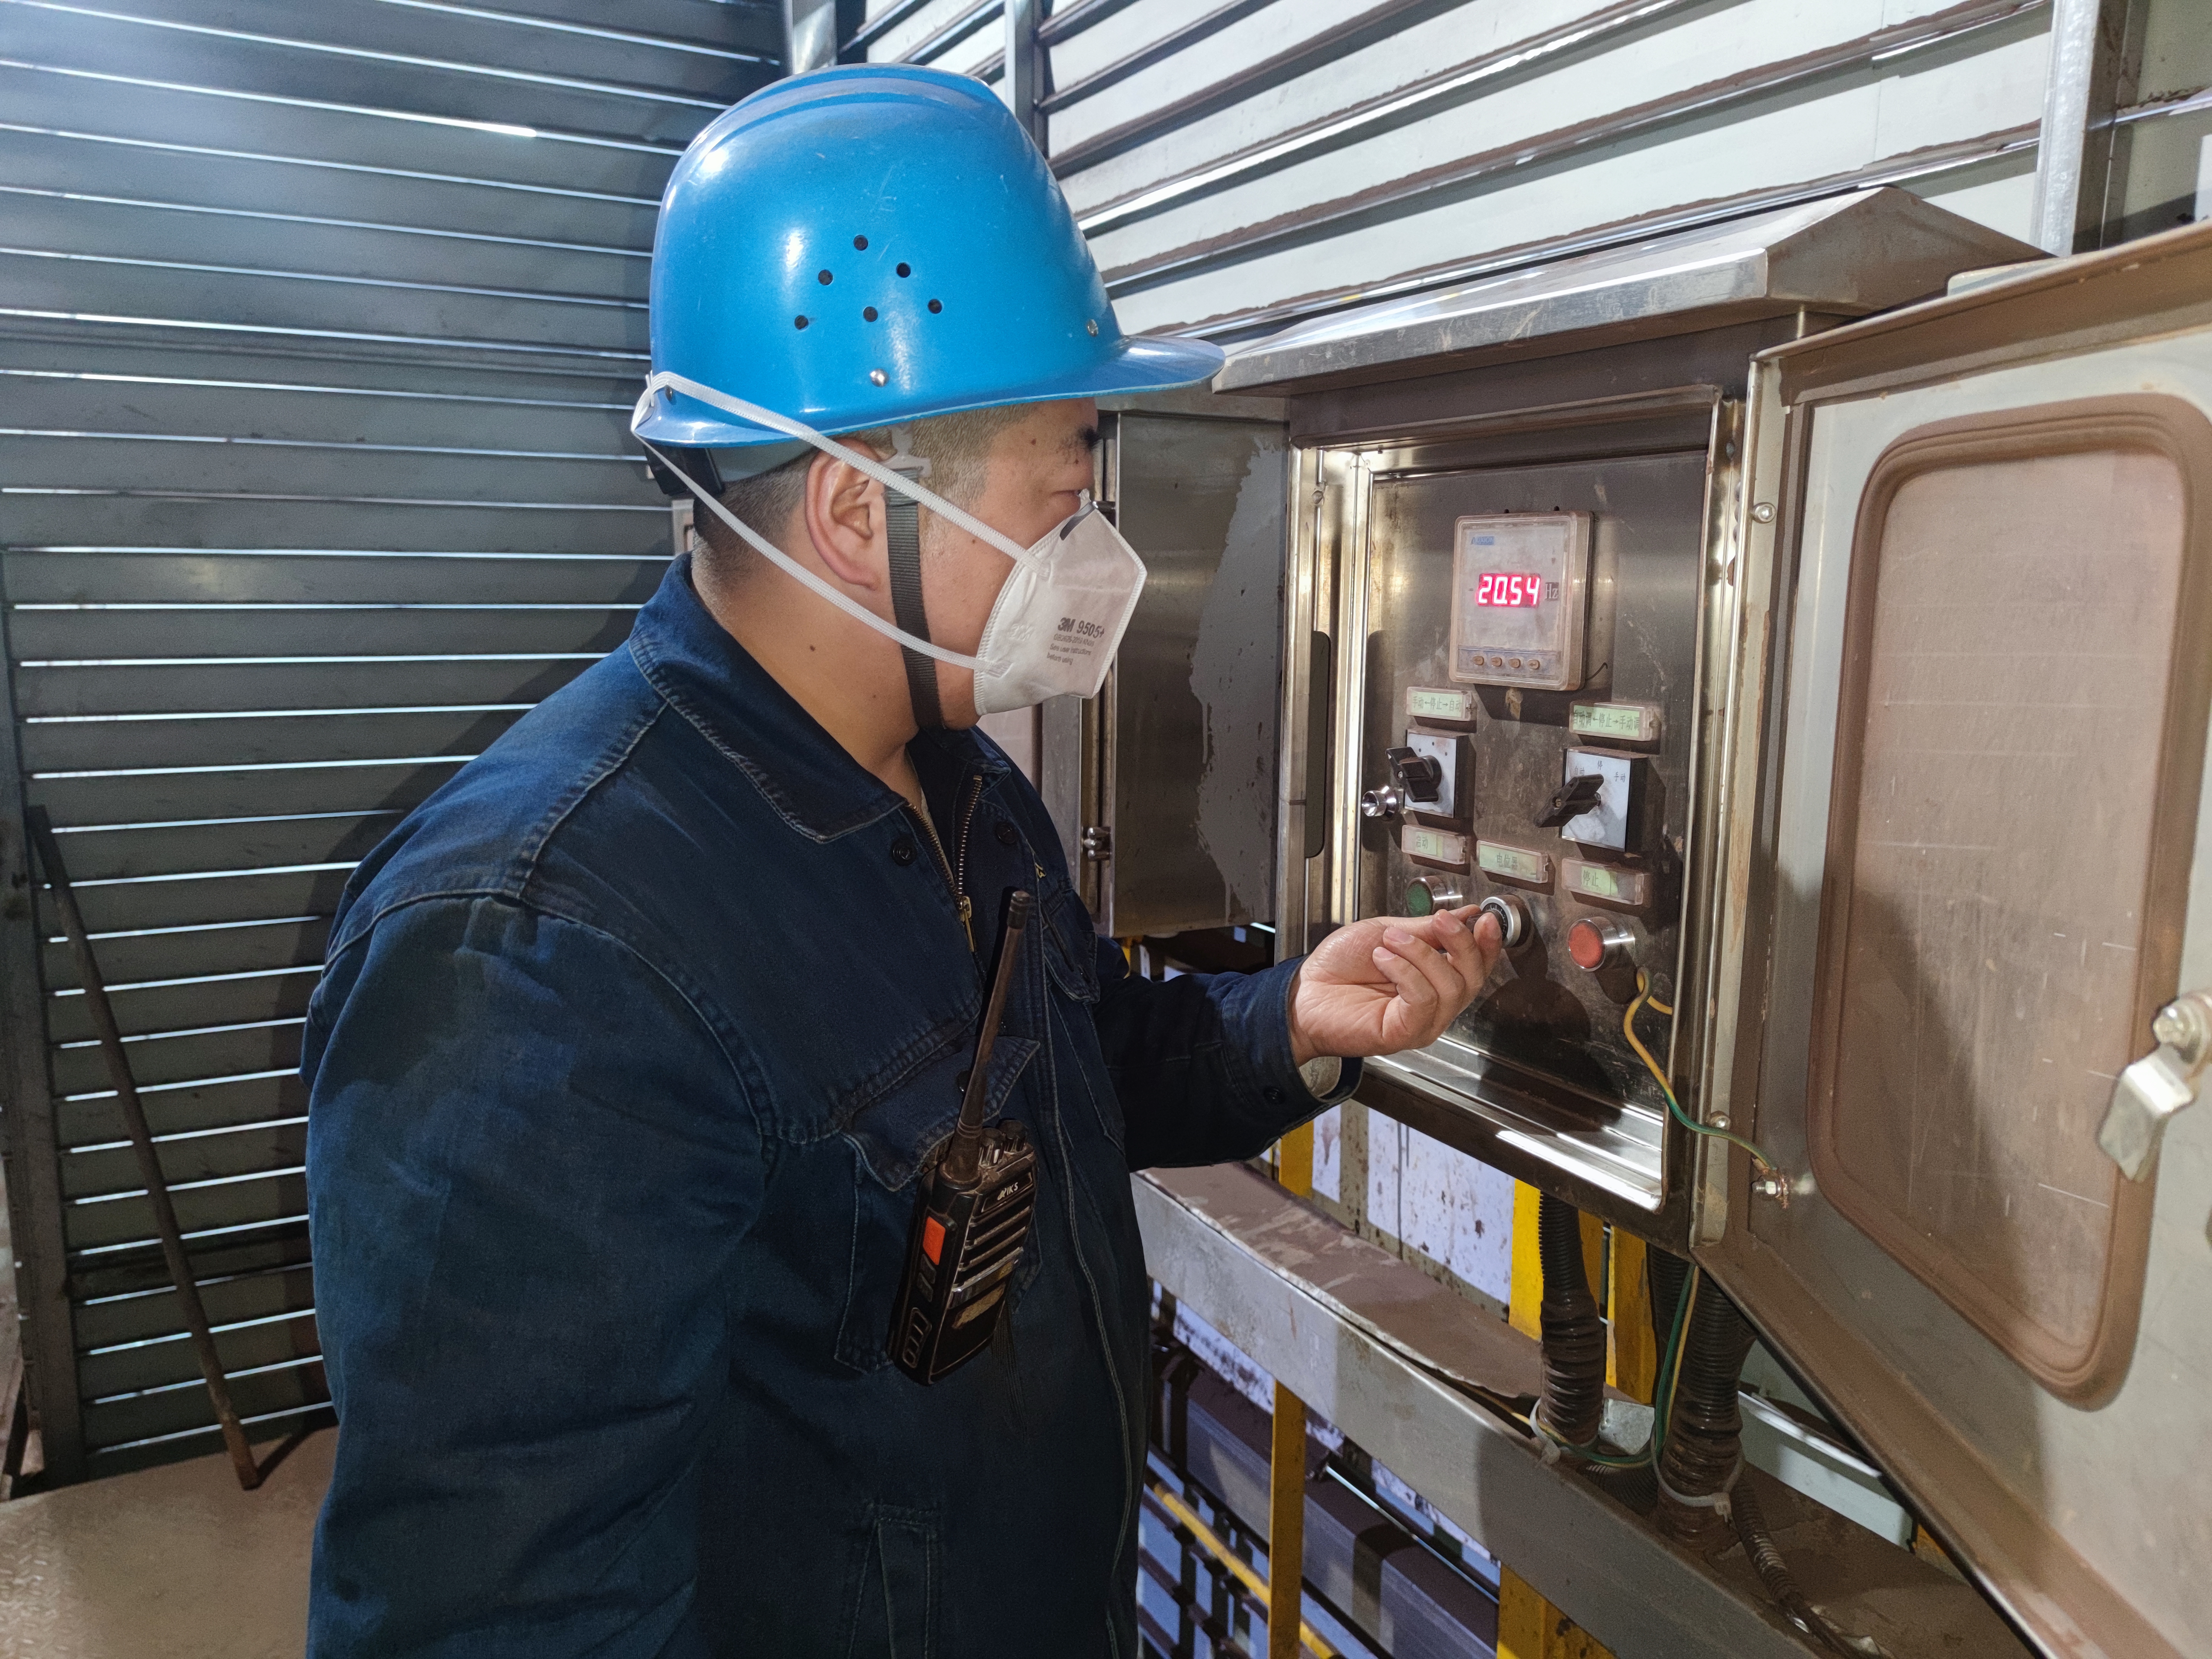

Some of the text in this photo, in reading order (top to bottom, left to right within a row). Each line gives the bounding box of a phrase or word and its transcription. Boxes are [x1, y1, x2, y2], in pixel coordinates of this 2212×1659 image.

[1545, 583, 1559, 600] Hz
[1057, 617, 1104, 639] 3M 9505+
[1583, 870, 1599, 887] 停止
